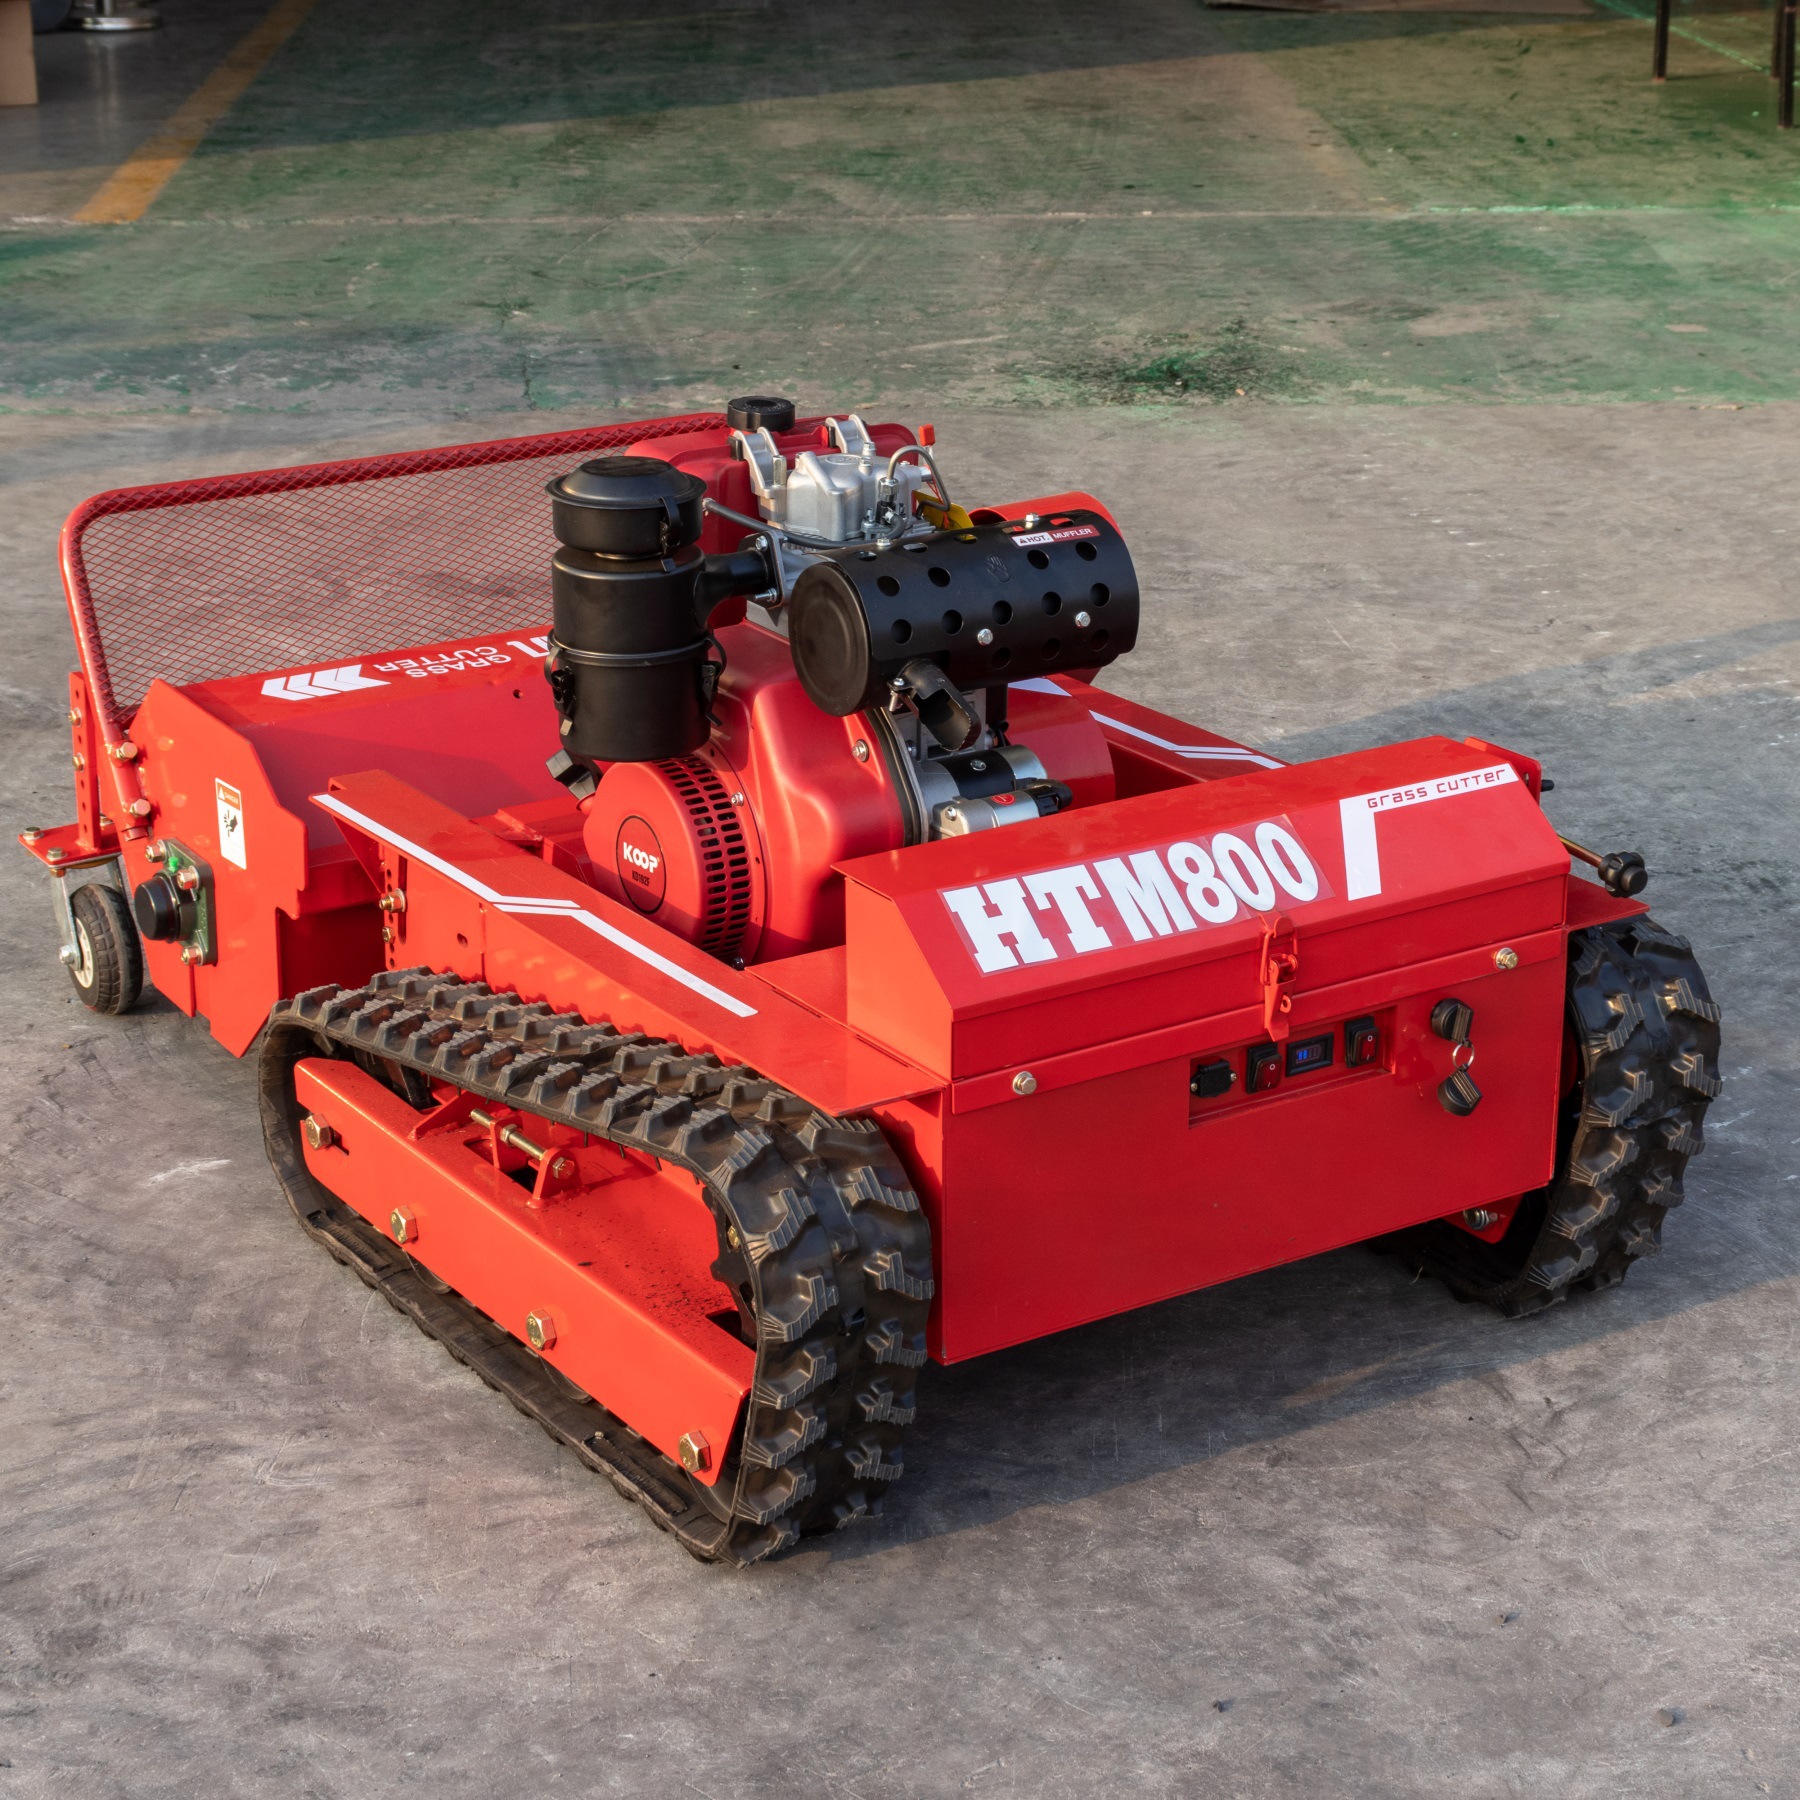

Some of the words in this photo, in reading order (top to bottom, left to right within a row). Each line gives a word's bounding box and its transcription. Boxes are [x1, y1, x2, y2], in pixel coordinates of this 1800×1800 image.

[1053, 528, 1092, 539] MUFFLER
[373, 646, 498, 671] CUTTER
[405, 654, 512, 678] GRASS
[623, 842, 658, 873] KOOP
[943, 822, 1319, 973] HTM800
